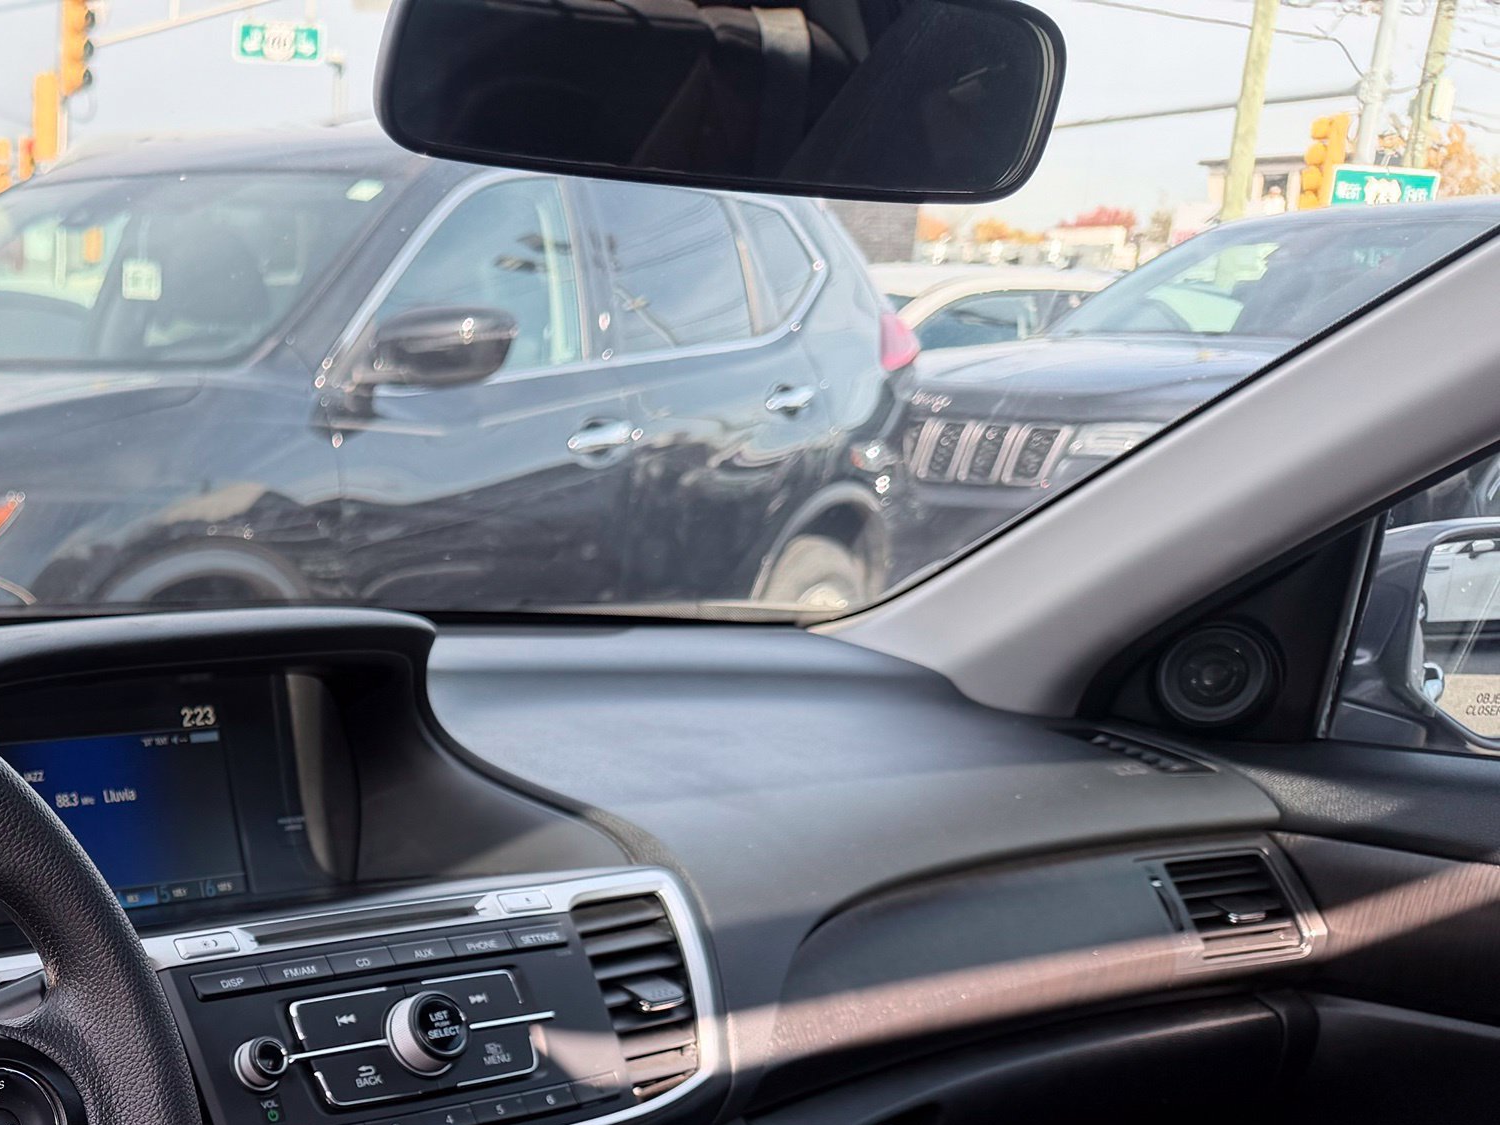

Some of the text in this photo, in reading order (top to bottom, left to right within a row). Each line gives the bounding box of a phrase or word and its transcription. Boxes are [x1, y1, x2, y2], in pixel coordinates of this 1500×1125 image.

[181, 706, 216, 727] 2:23
[519, 931, 560, 946] SETTINGS
[466, 939, 499, 952] PHONE
[414, 947, 435, 960] AUX
[354, 957, 372, 969] CD
[283, 964, 318, 979] FM/AM
[220, 977, 245, 990] DISP
[428, 1010, 450, 1022] LIST
[427, 1025, 461, 1040] SELECT
[482, 1052, 512, 1066] MENU
[355, 1074, 383, 1088] BACK
[260, 1099, 279, 1110] VOL
[545, 1094, 555, 1106] 6
[495, 1104, 505, 1116] 5
[444, 1113, 454, 1125] 4
